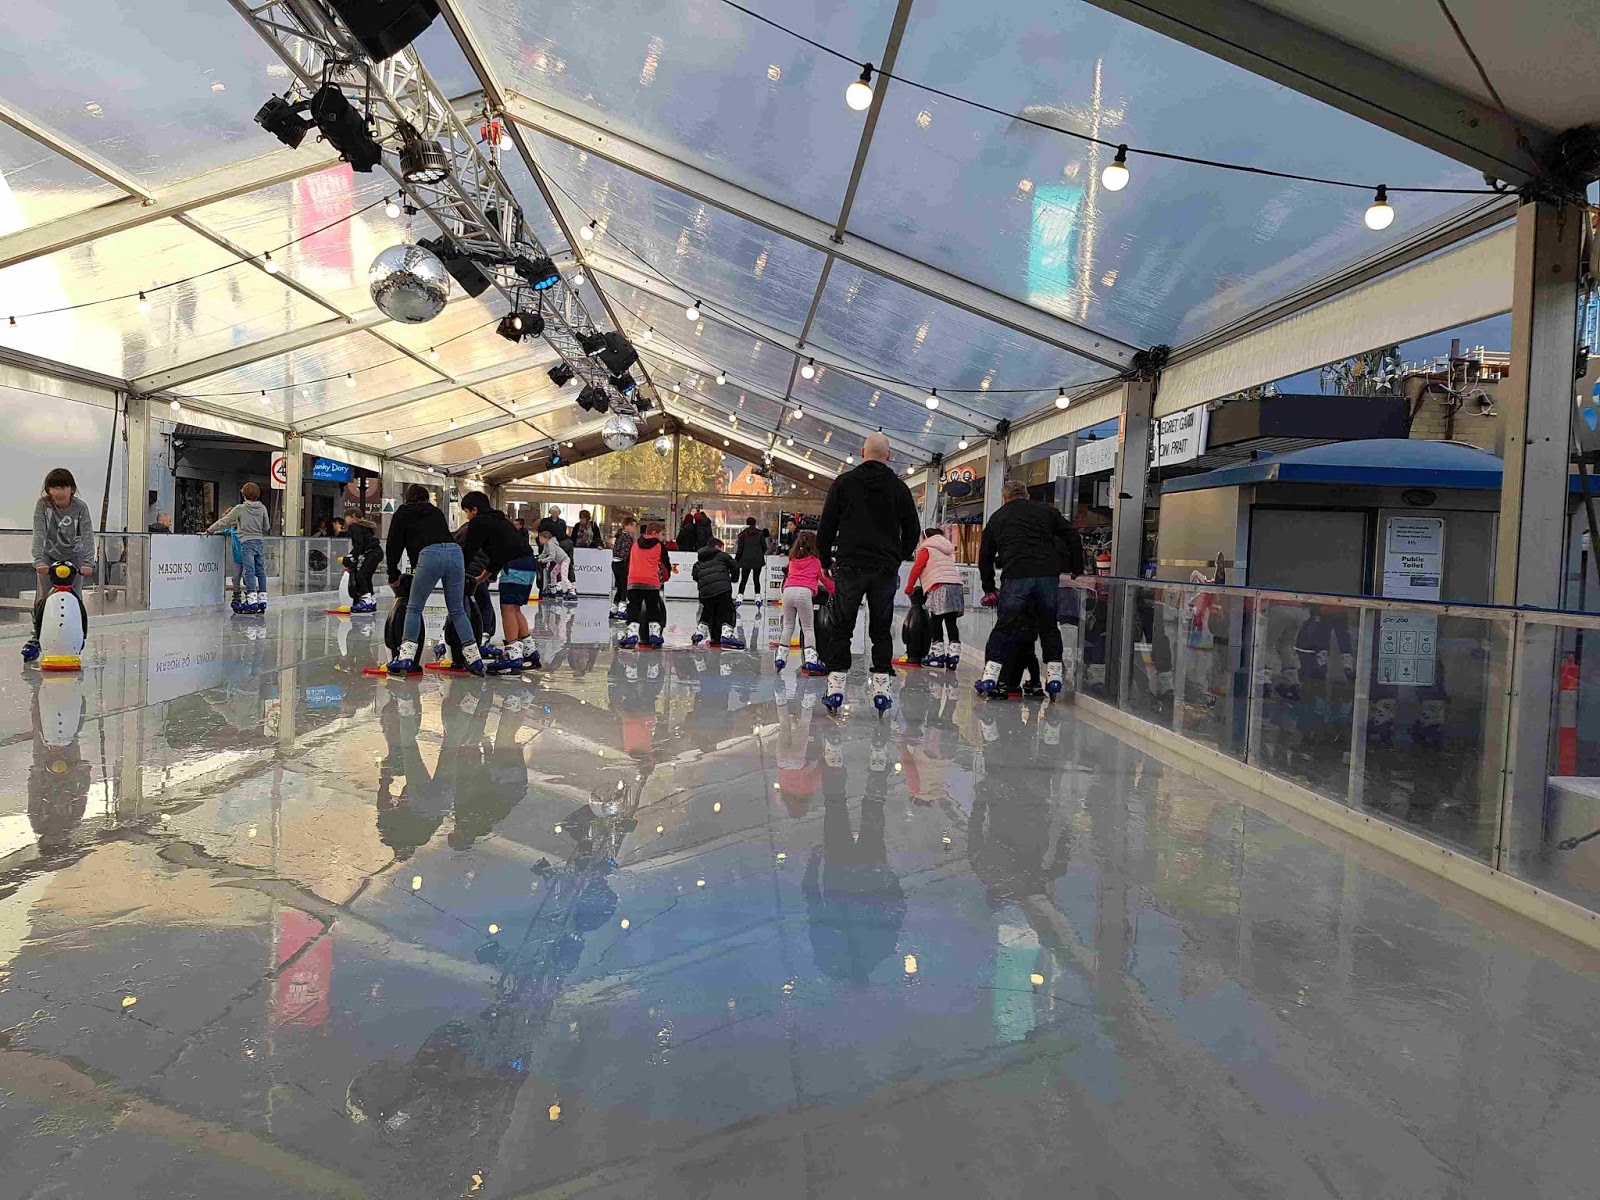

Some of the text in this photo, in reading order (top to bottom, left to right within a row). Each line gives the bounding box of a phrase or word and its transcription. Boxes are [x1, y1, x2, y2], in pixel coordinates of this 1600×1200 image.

[331, 462, 350, 474] Dory
[158, 562, 218, 574] MASON SQ CAYDON
[573, 564, 602, 572] CAYDON
